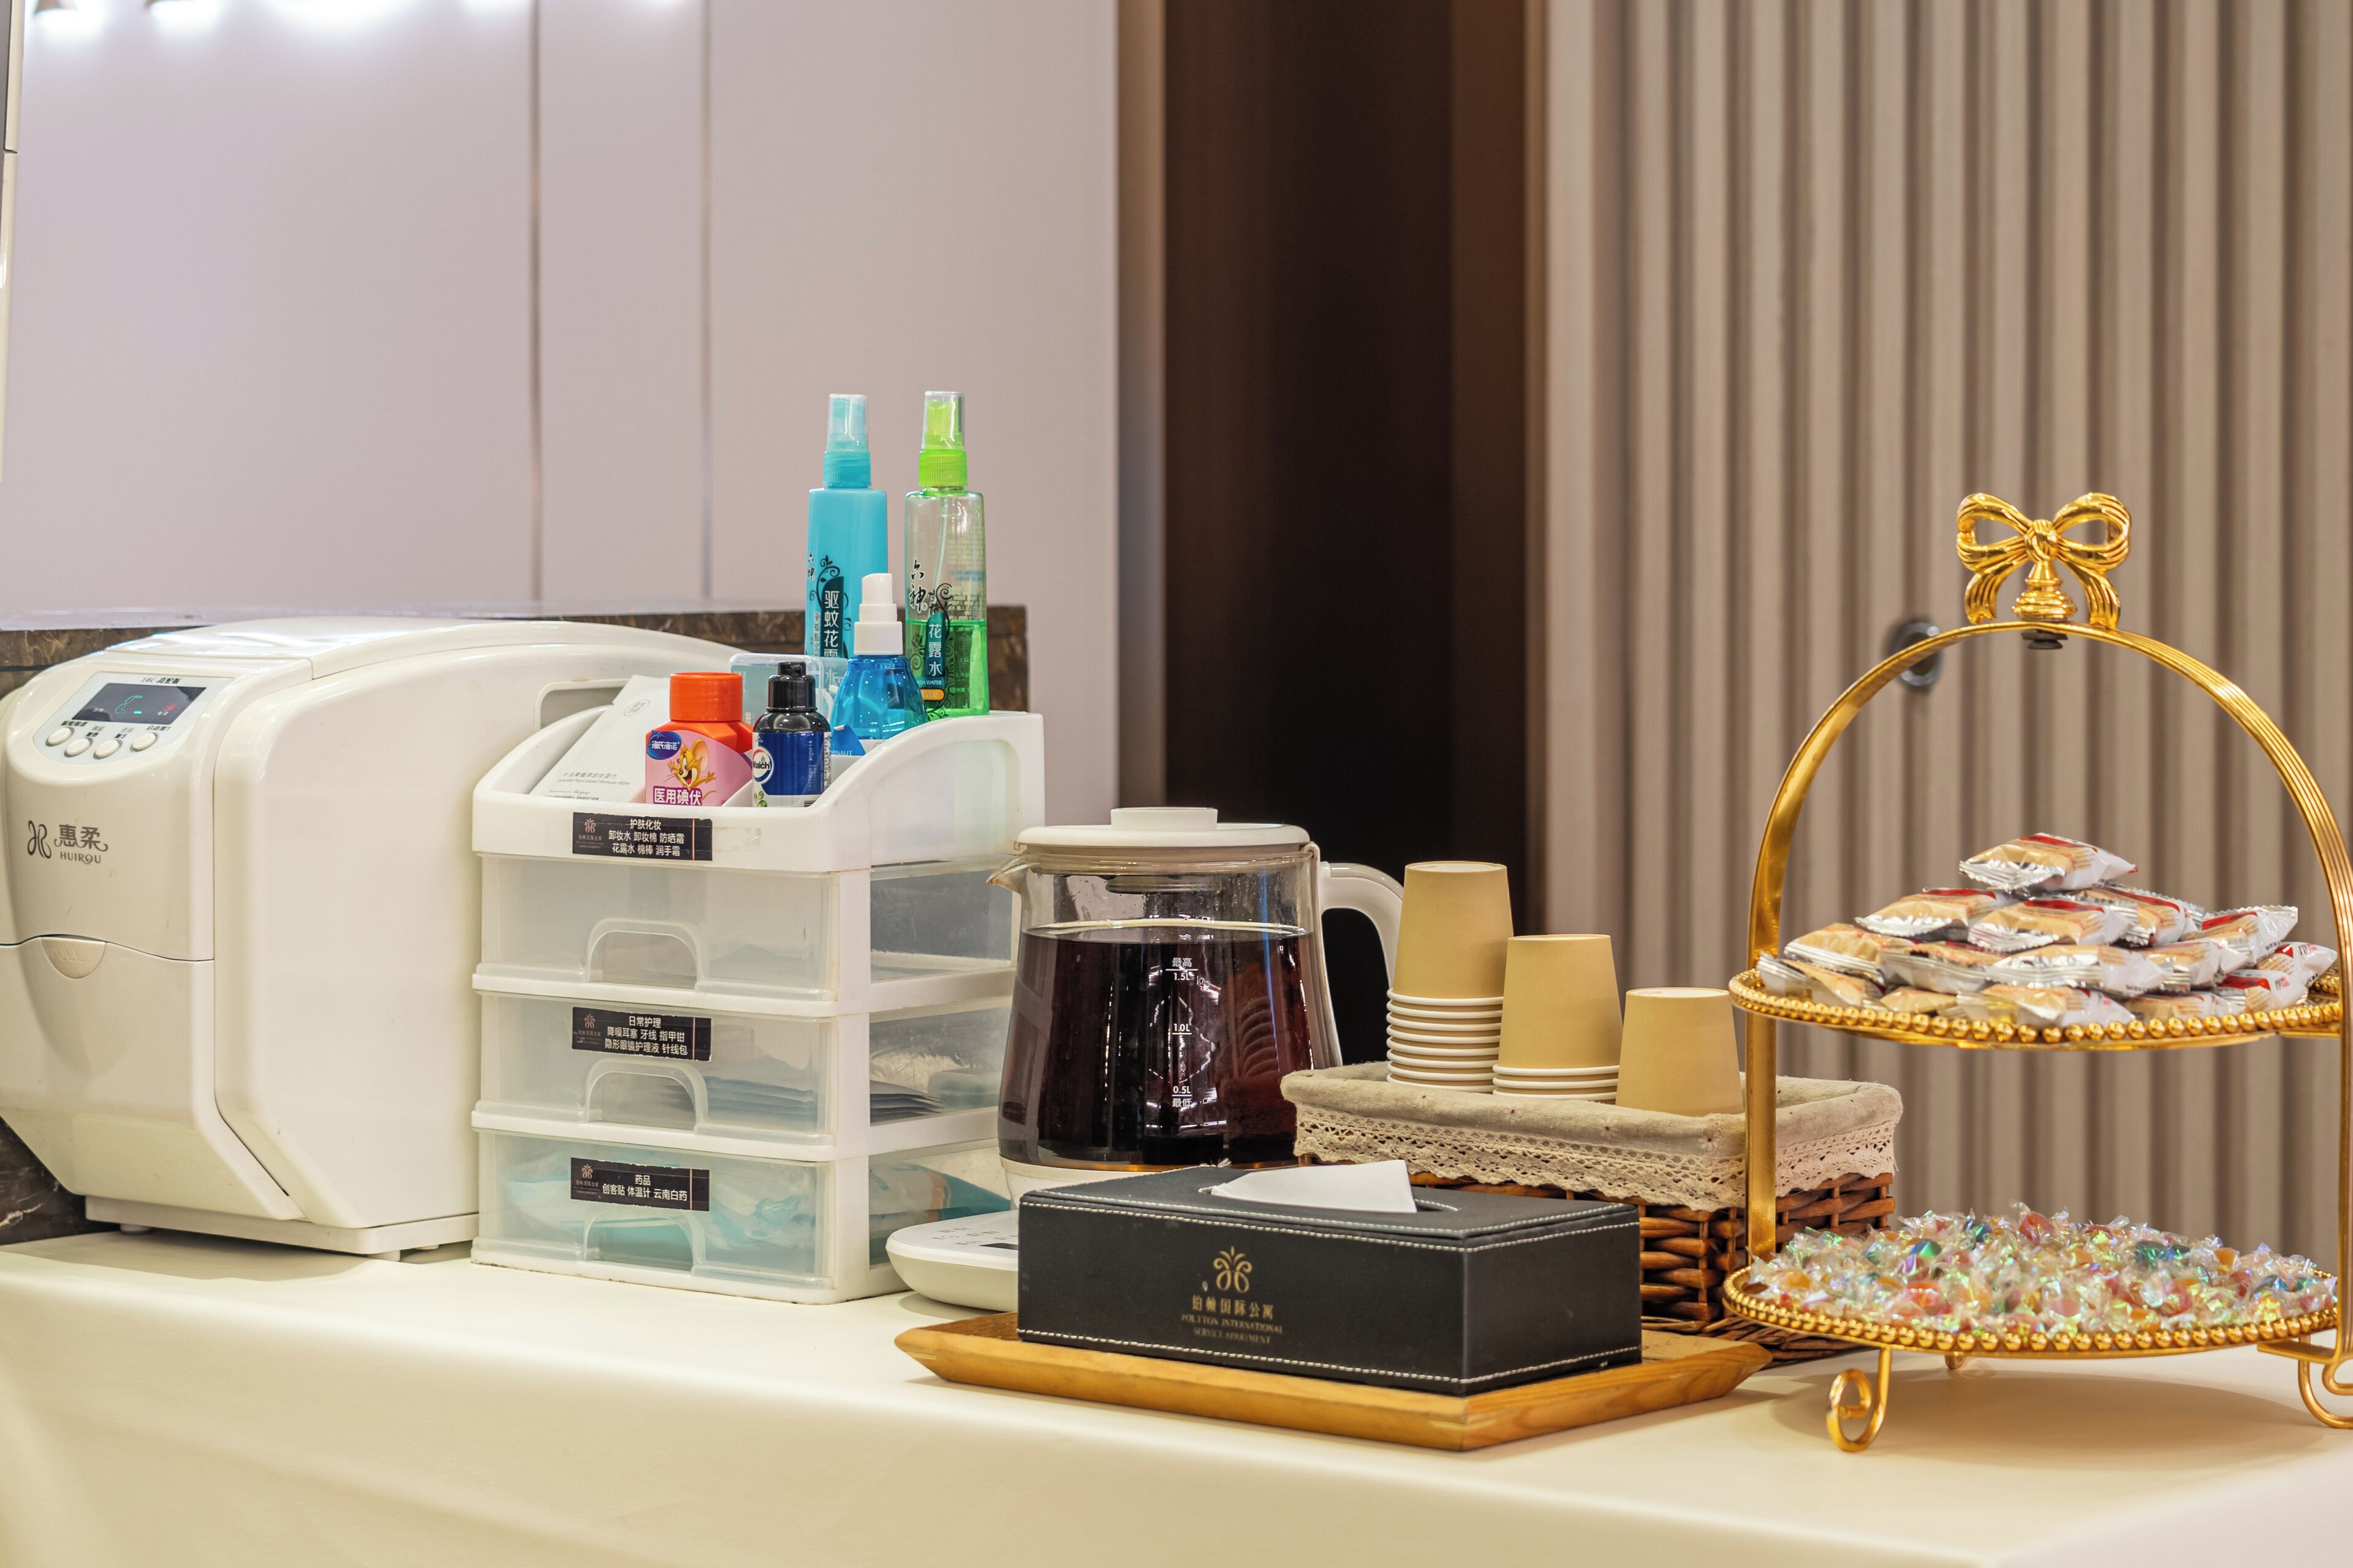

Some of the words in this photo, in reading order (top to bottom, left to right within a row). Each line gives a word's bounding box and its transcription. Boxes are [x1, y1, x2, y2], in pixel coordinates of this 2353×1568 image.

[909, 558, 926, 612] 六神
[928, 624, 942, 676] 花露水
[654, 787, 702, 806] 医用碘伏
[629, 818, 662, 831] 护肤化妆
[54, 824, 108, 852] 惠柔
[608, 830, 632, 841] 卸妆水
[633, 831, 657, 843] 卸妆棉
[659, 833, 684, 844] 防晒霜
[612, 843, 635, 855] 花露水
[637, 844, 654, 855] 棉棒
[656, 845, 681, 857] 润手霜
[60, 852, 102, 865] HUIROU
[1172, 957, 1192, 968] 最高
[629, 1016, 661, 1029] 日常护理
[1173, 1023, 1191, 1032] 1.0L
[607, 1026, 638, 1039] 降噪耳塞
[640, 1029, 657, 1041] 牙线
[659, 1031, 685, 1043] 指甲钳
[605, 1038, 660, 1054] 隐形眼镜护理液
[662, 1043, 688, 1055] 针线包
[1172, 1097, 1192, 1108] 最低
[635, 1175, 651, 1186] 药品
[602, 1183, 626, 1195] 创客贴
[627, 1186, 651, 1199] 体温计
[653, 1188, 688, 1202] 云南白药
